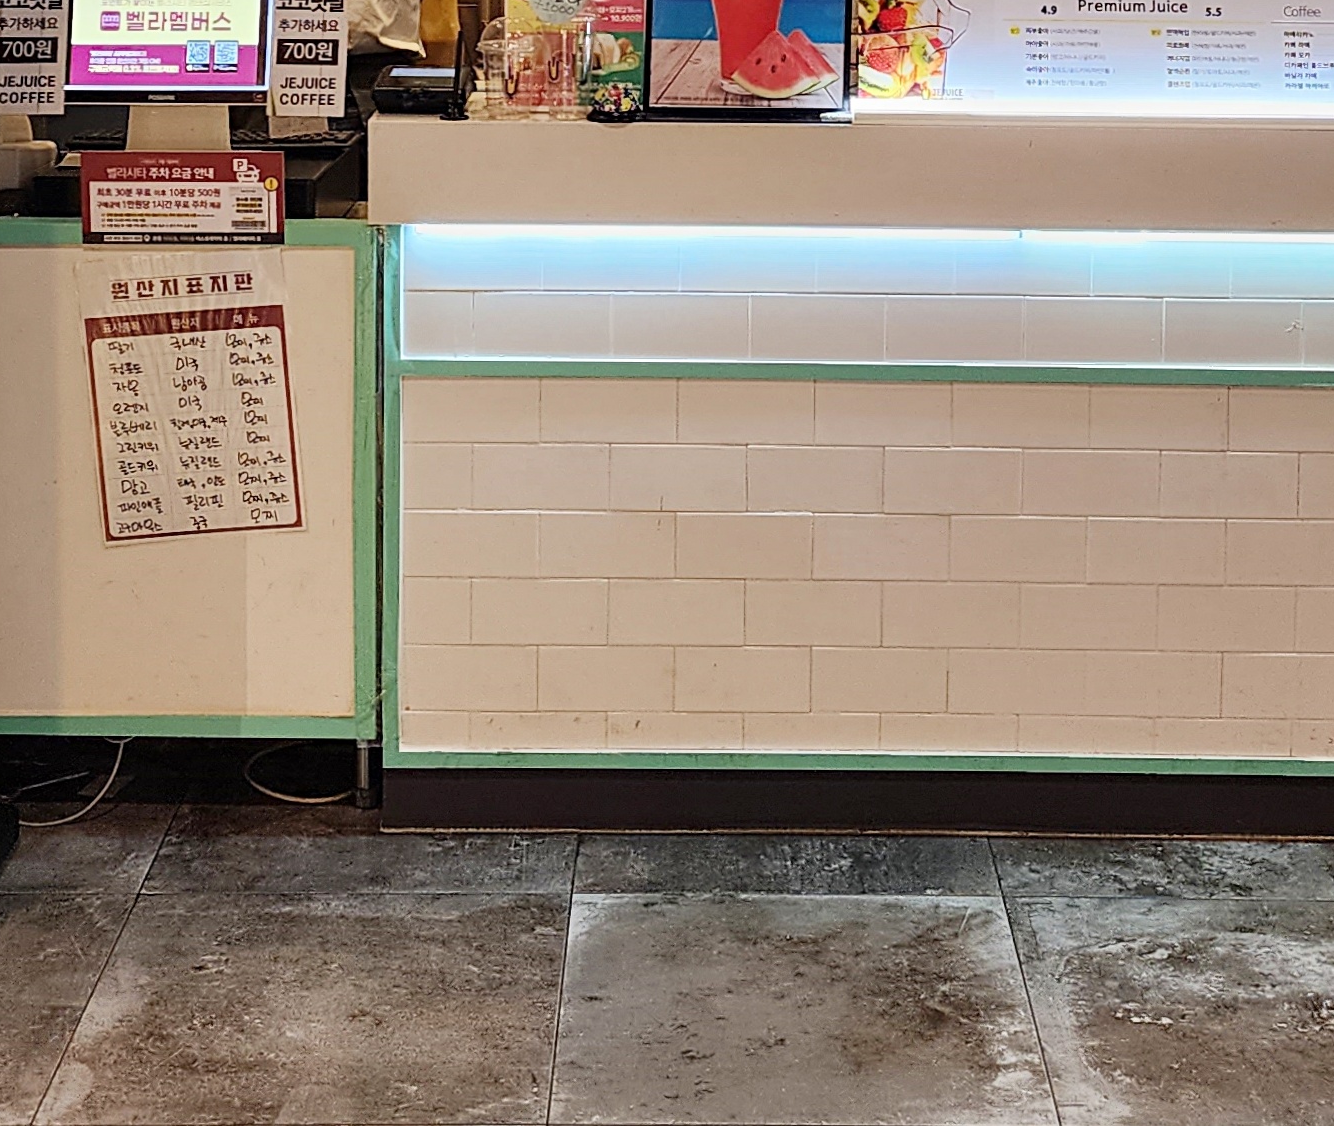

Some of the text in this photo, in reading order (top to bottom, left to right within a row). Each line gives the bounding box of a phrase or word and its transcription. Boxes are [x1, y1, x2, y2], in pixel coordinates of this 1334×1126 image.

[1041, 0, 1222, 17] 4.9 Premium Juice 5.5
[1284, 6, 1321, 17] Coffee
[126, 11, 231, 31] 벨라멤버스
[278, 18, 339, 32] 추가하세요
[1, 40, 53, 59] 700원
[283, 42, 334, 61] 700원
[0, 75, 56, 88] JEJUICE
[280, 77, 336, 90] JEJUICE
[279, 93, 335, 105] COFFEE
[149, 167, 169, 179] 주차
[172, 167, 192, 179] 요금
[194, 167, 214, 179] 안내
[115, 188, 132, 197] 30분
[170, 188, 195, 197] 10분당
[198, 188, 220, 197] 500원
[153, 201, 172, 209] 1시간
[169, 337, 206, 350] 국내산
[176, 357, 198, 371] 미국
[179, 396, 202, 411] 미국
[121, 479, 150, 494] 망고
[182, 495, 224, 508] 필리핀
